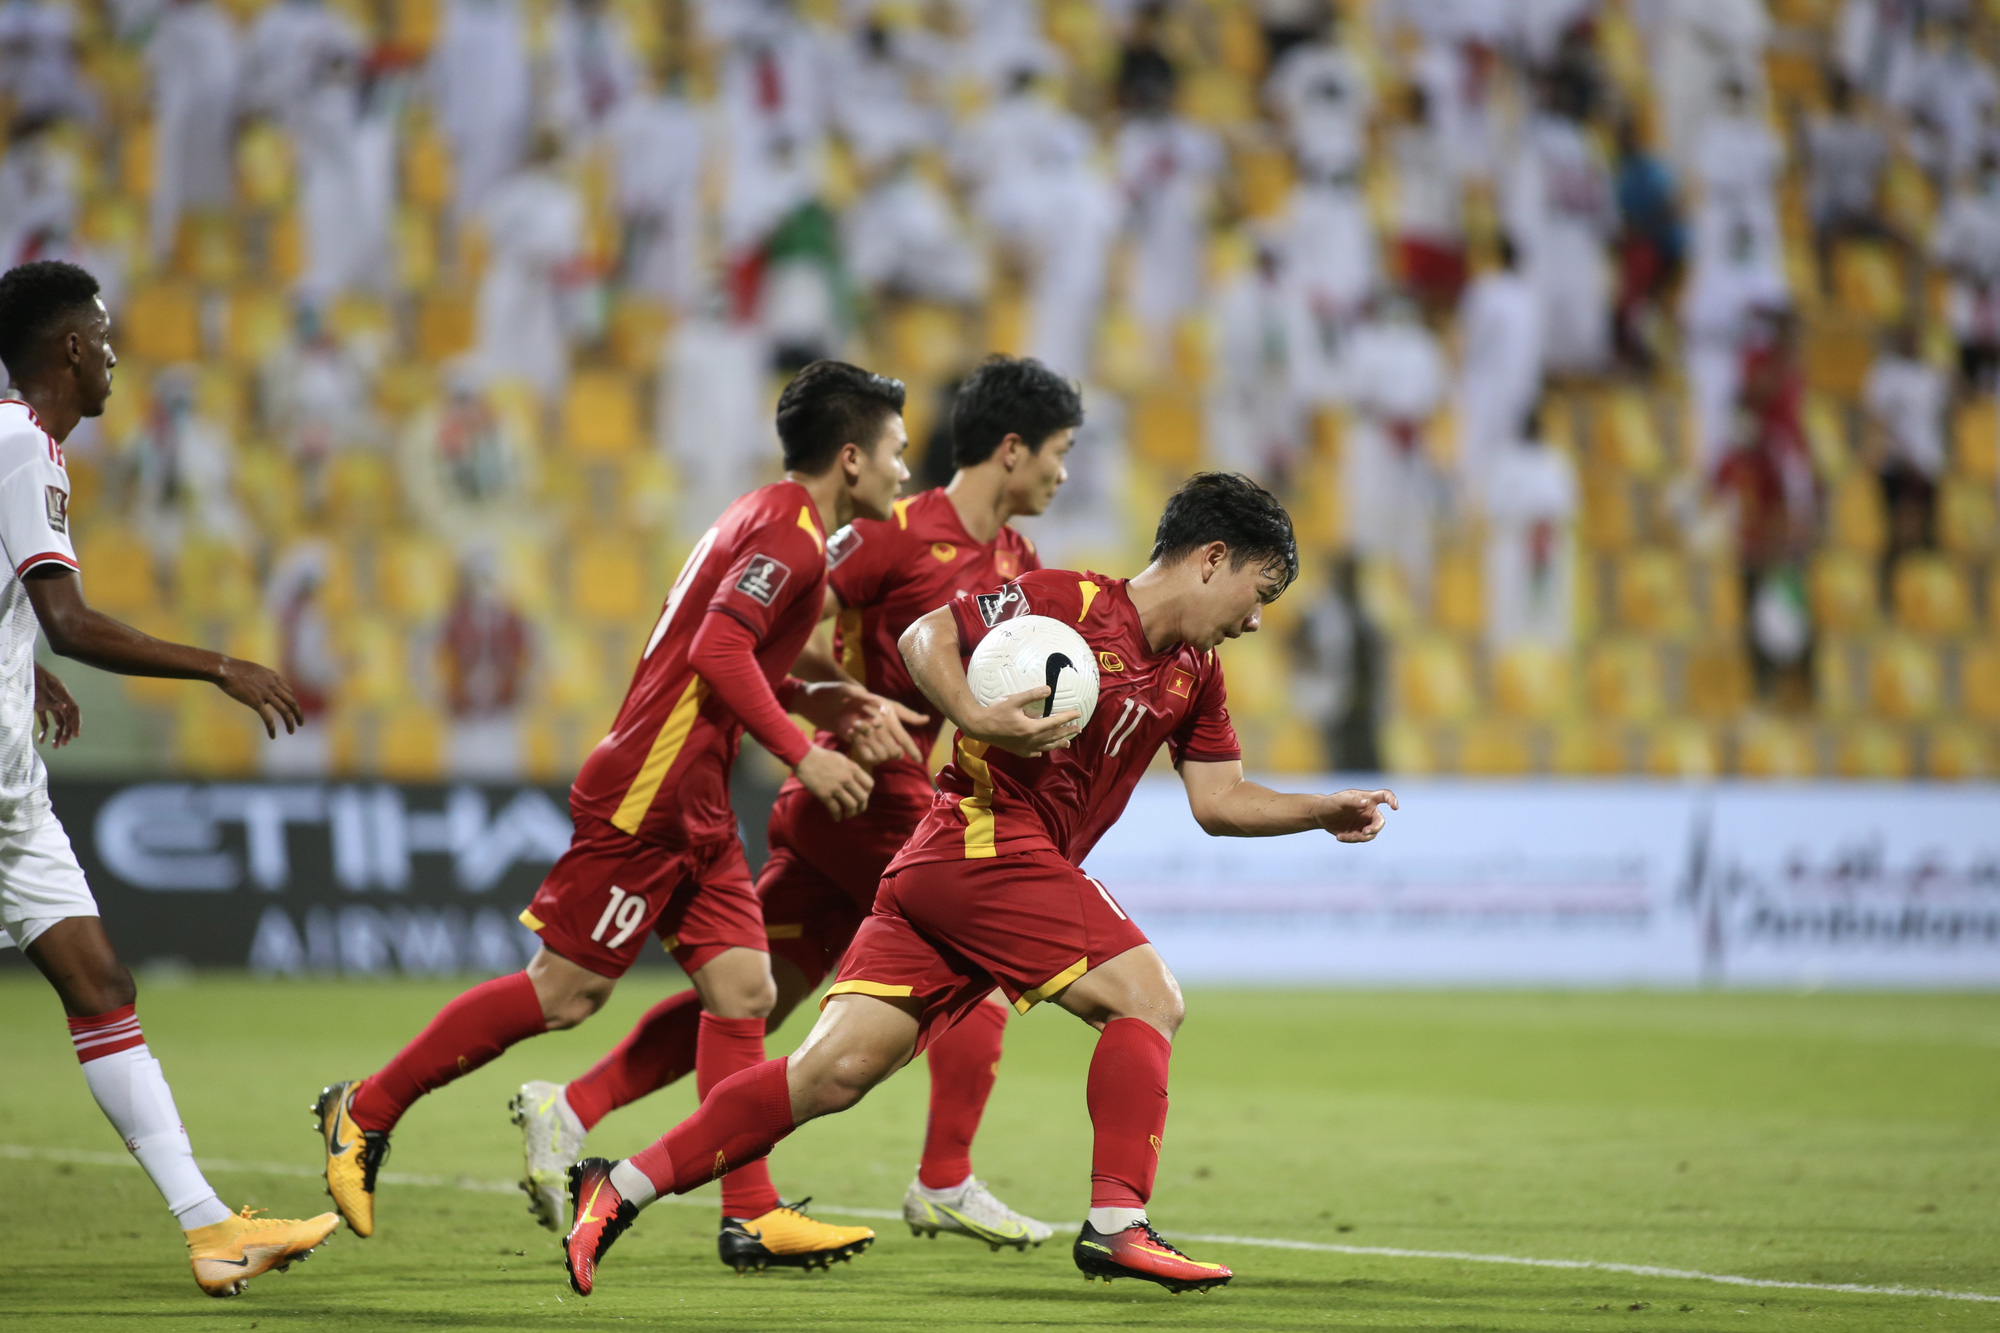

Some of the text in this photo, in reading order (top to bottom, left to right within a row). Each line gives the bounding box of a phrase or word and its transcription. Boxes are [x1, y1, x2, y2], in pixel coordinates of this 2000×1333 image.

[1103, 697, 1148, 758] 11
[94, 784, 573, 892] ETIHA
[590, 884, 647, 949] 19
